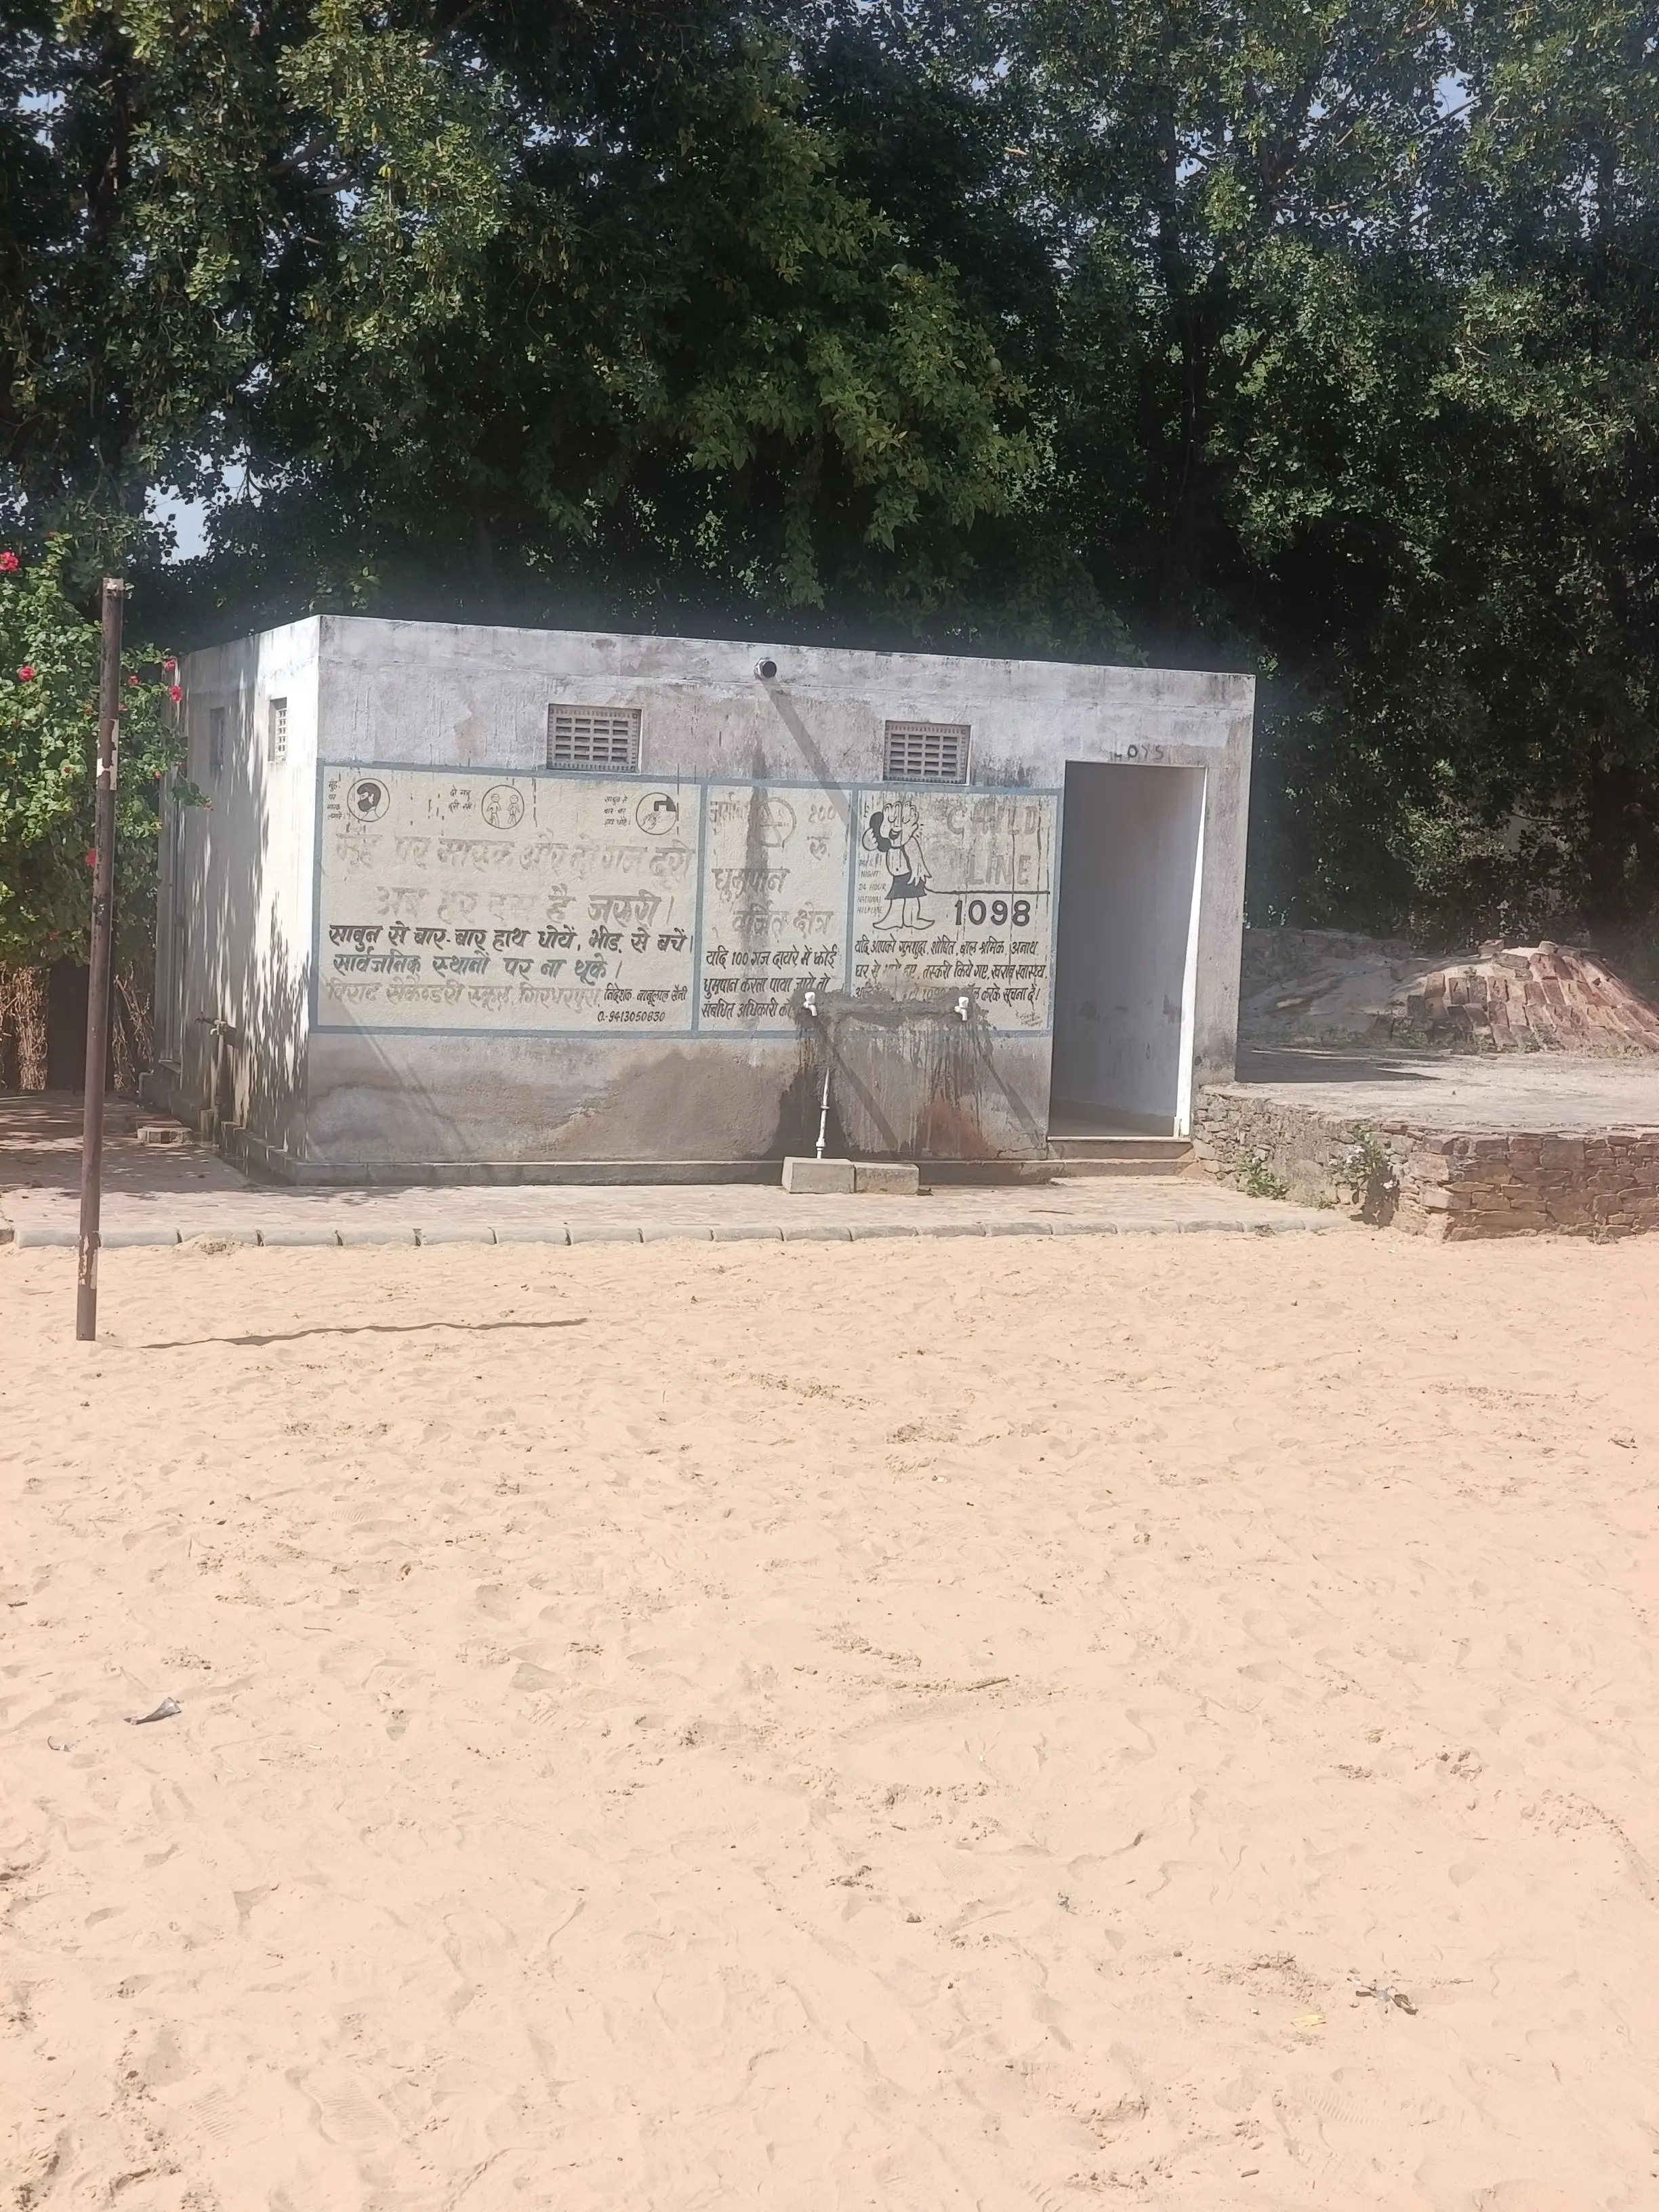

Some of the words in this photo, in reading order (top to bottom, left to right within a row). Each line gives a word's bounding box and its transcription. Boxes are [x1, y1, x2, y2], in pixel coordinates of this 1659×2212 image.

[1114, 744, 1164, 762] OYS
[967, 855, 1031, 885] LINE
[869, 883, 886, 892] HOUR
[546, 882, 577, 924] है
[955, 900, 1031, 926] 1098
[329, 924, 383, 952] साबुन
[388, 920, 411, 946] से
[492, 927, 531, 952] हाथ
[630, 926, 651, 954] से
[855, 935, 869, 955] यदि
[871, 933, 897, 954] आपको
[960, 941, 978, 956] बाल
[333, 945, 422, 977] सार्वजनिक
[432, 950, 491, 978] स्थानों
[503, 957, 535, 981] पर
[540, 959, 567, 979] ना
[706, 945, 729, 969] यदि
[732, 951, 749, 966] 100
[751, 951, 771, 966] गज
[773, 945, 799, 969] दायरे
[801, 945, 813, 966] में
[814, 943, 838, 968] कोई
[855, 964, 869, 978] घर
[922, 960, 953, 979] तस्करी
[954, 960, 973, 978] किये
[991, 965, 1016, 980] खराब
[741, 977, 769, 994] करता
[770, 977, 794, 993] पाया
[817, 972, 831, 992] तो
[637, 990, 670, 1006] बाबूलाल
[671, 985, 688, 1002] सैनी
[981, 983, 1001, 1002] करके
[1003, 987, 1029, 1007] सूचना
[737, 997, 779, 1018] अधिकारी
